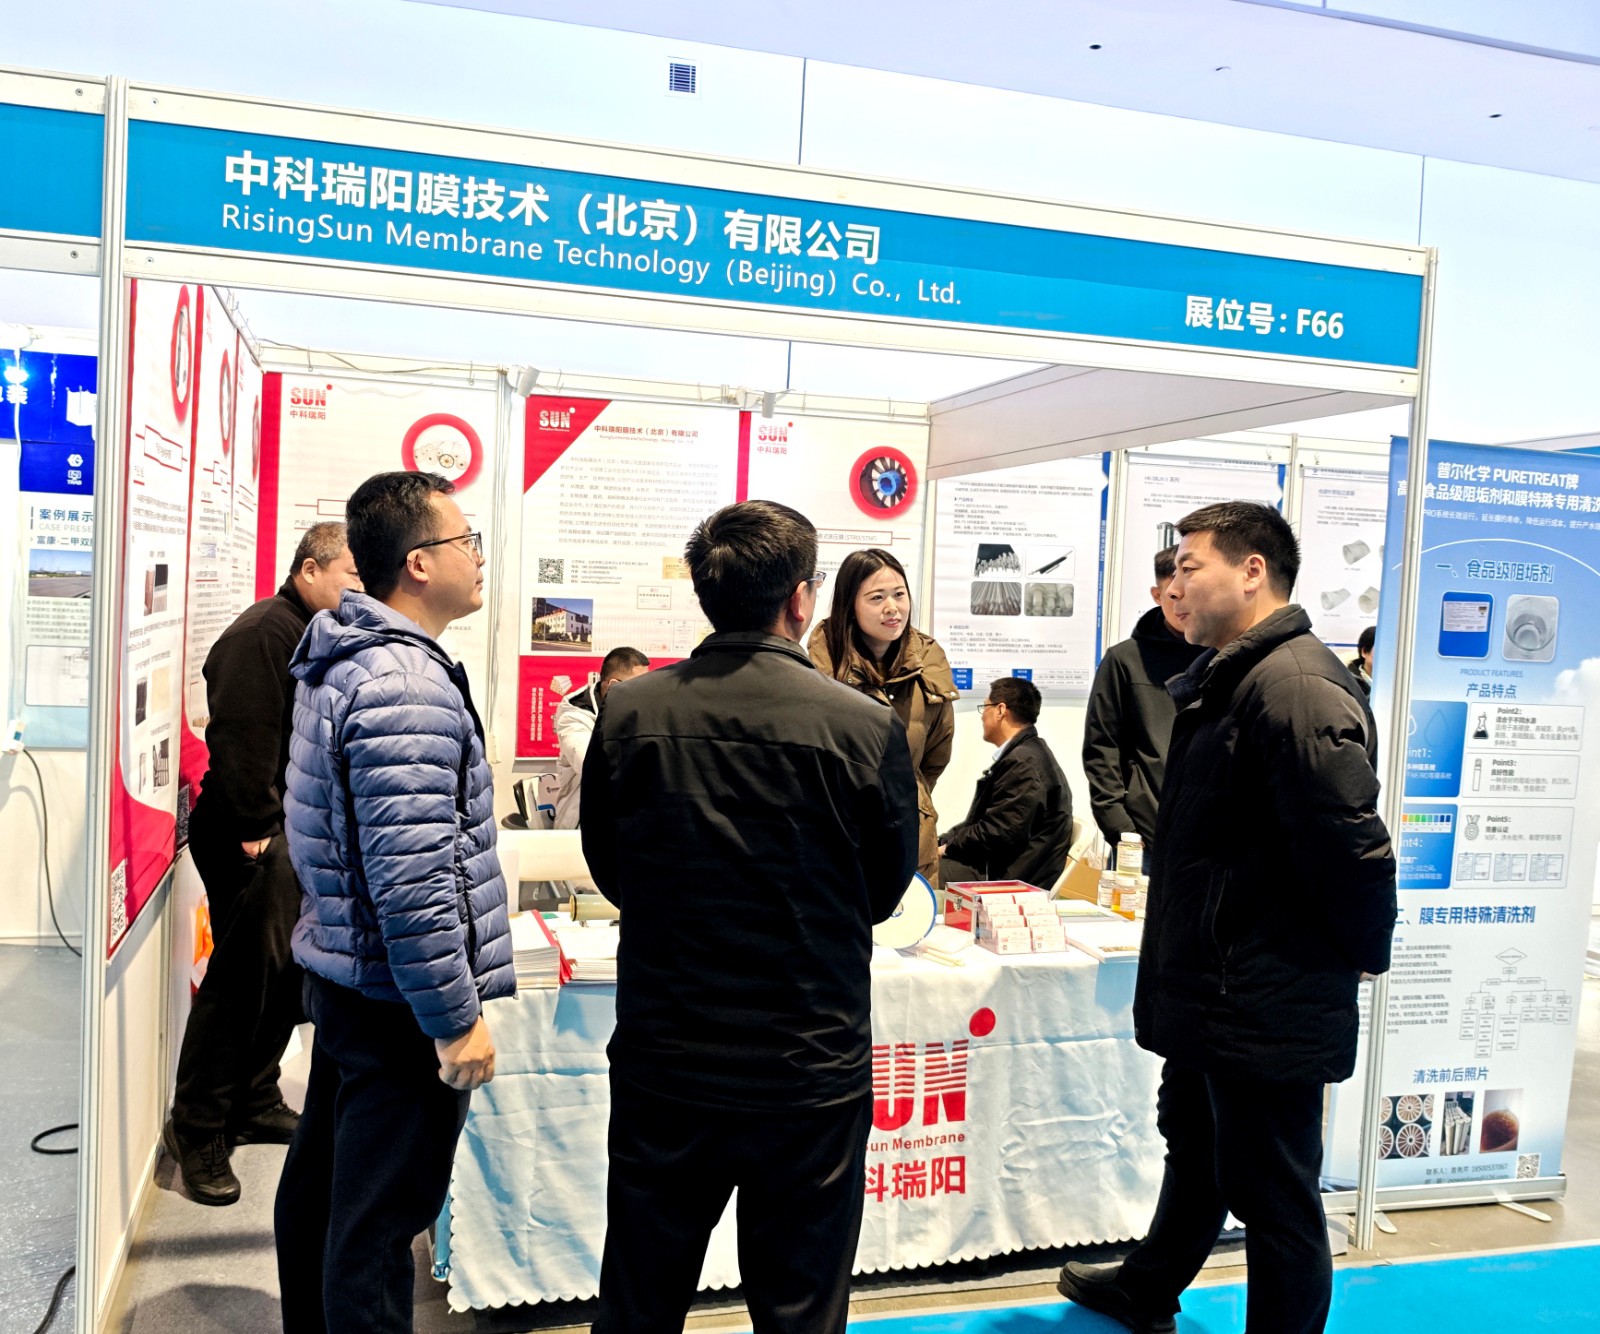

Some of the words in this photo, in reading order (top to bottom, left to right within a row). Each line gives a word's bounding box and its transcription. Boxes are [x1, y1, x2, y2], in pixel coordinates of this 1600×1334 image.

[224, 150, 881, 265] 中科瑞阳膜技术（北京）有限公司
[221, 204, 372, 243] RisingSun
[385, 222, 542, 261] Membrane
[552, 239, 711, 285] Technology
[917, 279, 962, 305] Ltd.
[290, 386, 327, 406] SUN
[289, 410, 327, 420] 中科瑞阳
[539, 410, 571, 428] SUN
[758, 424, 788, 443] SUN
[1437, 462, 1491, 483] 普尔化学
[1493, 468, 1580, 490] PURETREAT牌
[1397, 480, 1600, 513] 高食品级阻垢剂和膜特殊专用清洗
[39, 508, 94, 523] 案例展示
[39, 523, 61, 531] CASE
[1436, 558, 1554, 583] 一、食品级阻垢剂
[1460, 668, 1491, 677] PRODUCT
[1491, 670, 1524, 678] FEATURES
[1466, 683, 1518, 699] 产品特点
[1395, 905, 1537, 926] 二、膜专用特殊清洗剂
[1412, 1066, 1490, 1084] 清洗前后照片
[892, 1132, 966, 1151] Membrane
